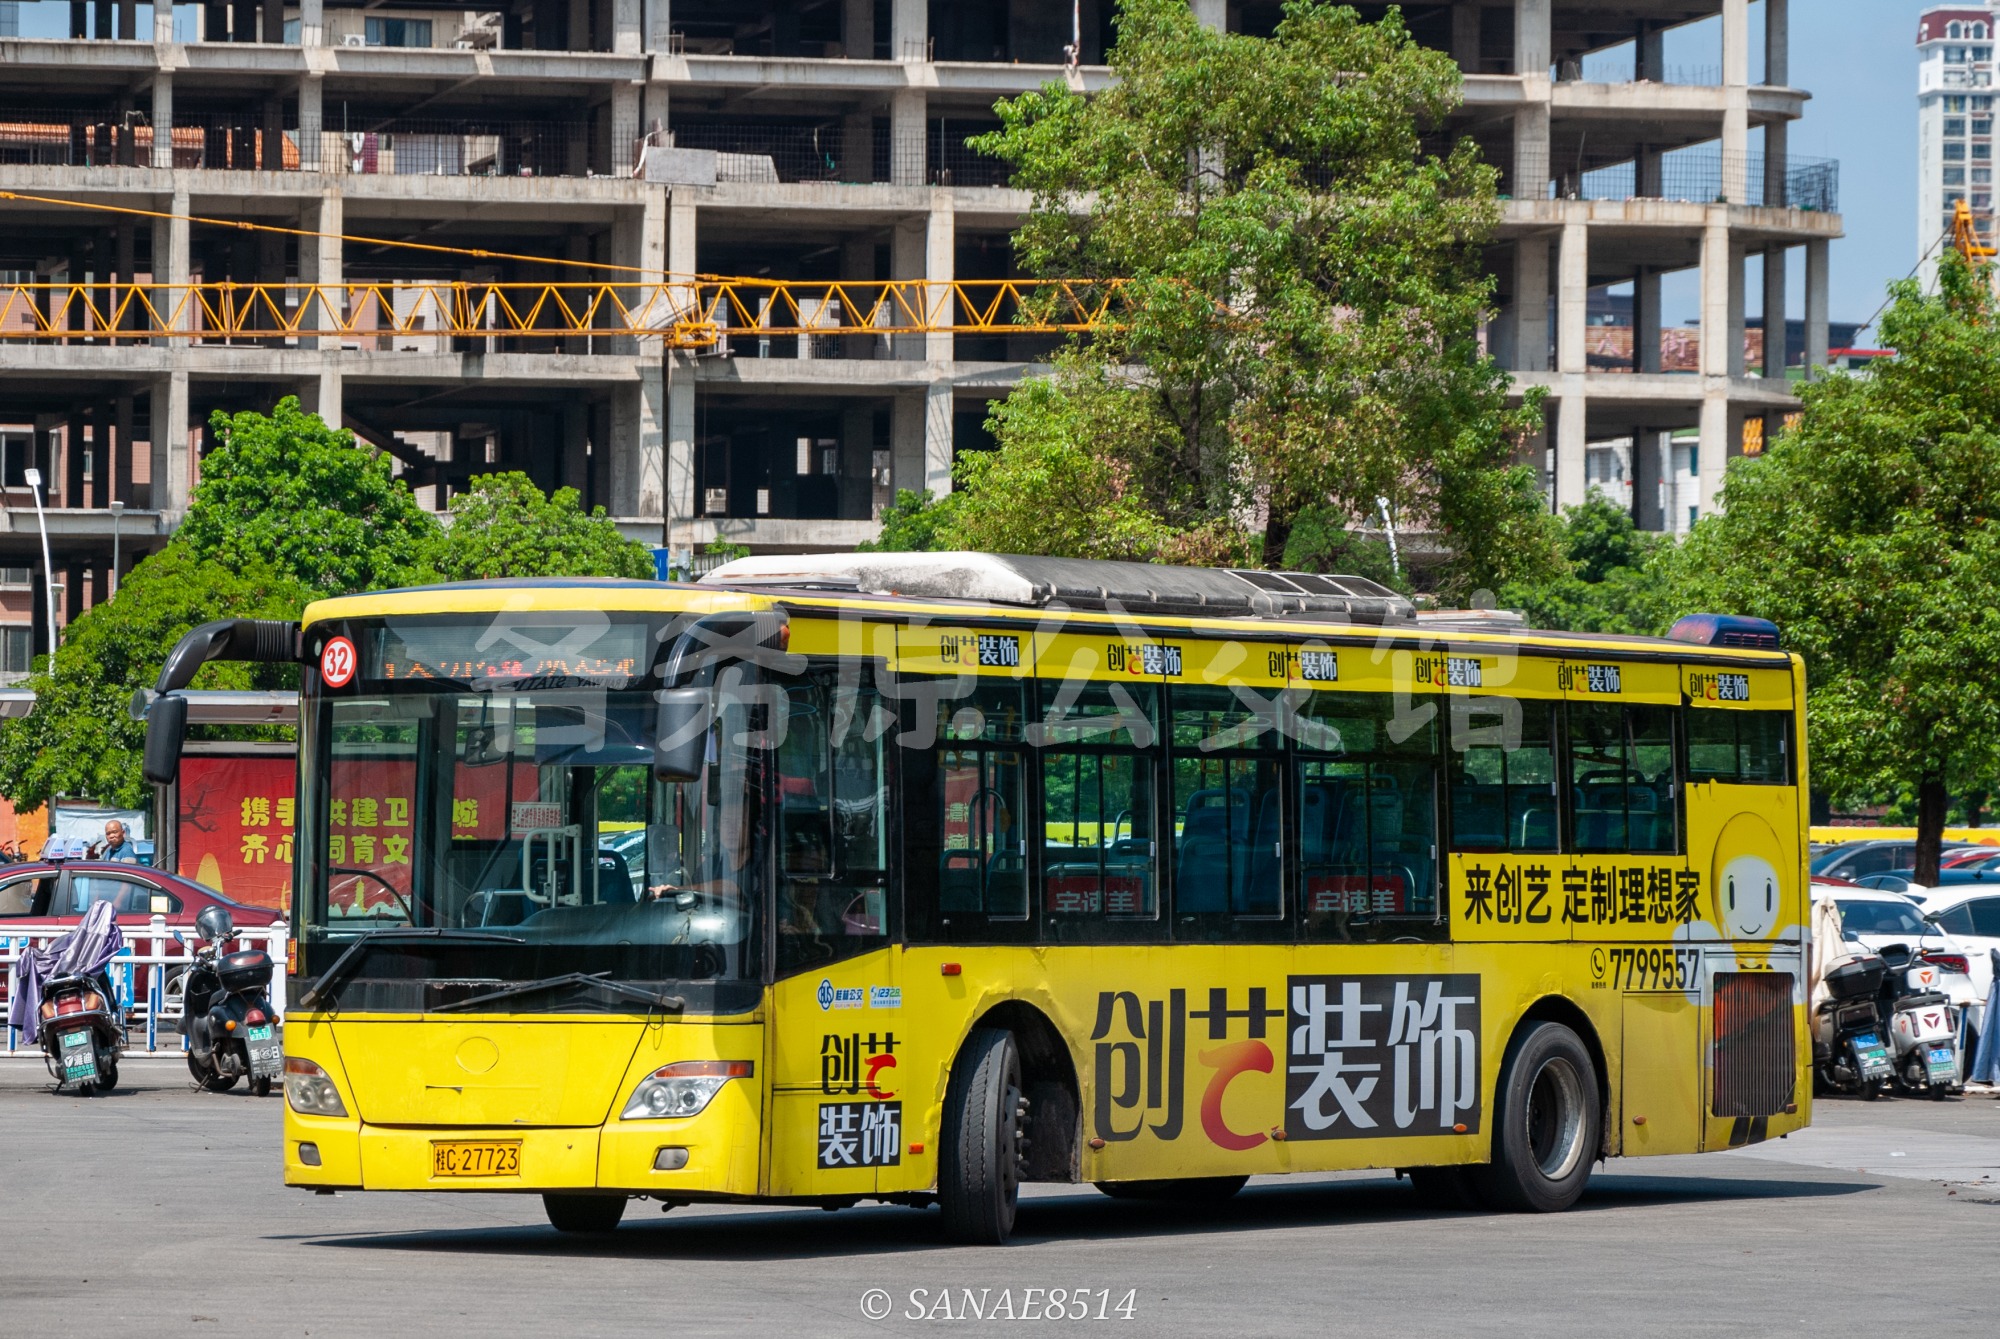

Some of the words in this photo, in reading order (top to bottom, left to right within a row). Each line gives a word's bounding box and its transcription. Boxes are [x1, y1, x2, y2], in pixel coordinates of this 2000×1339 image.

[327, 646, 348, 677] 32
[940, 635, 1019, 667] 创艺装饰
[1107, 643, 1182, 676] 创艺装饰
[1268, 651, 1338, 681] 创艺装饰
[1415, 657, 1482, 687] 创艺装饰
[1558, 664, 1621, 693] 创艺装饰
[1690, 673, 1749, 701] 创艺装饰
[1464, 863, 1552, 925] 来创艺
[1561, 864, 1702, 926] 定制理想家
[1609, 948, 1700, 990] 7799557
[877, 988, 900, 998] 12328
[820, 1032, 901, 1099] 创艺
[1090, 975, 1478, 1150] 创艺装饰
[819, 1103, 901, 1167] 装饰
